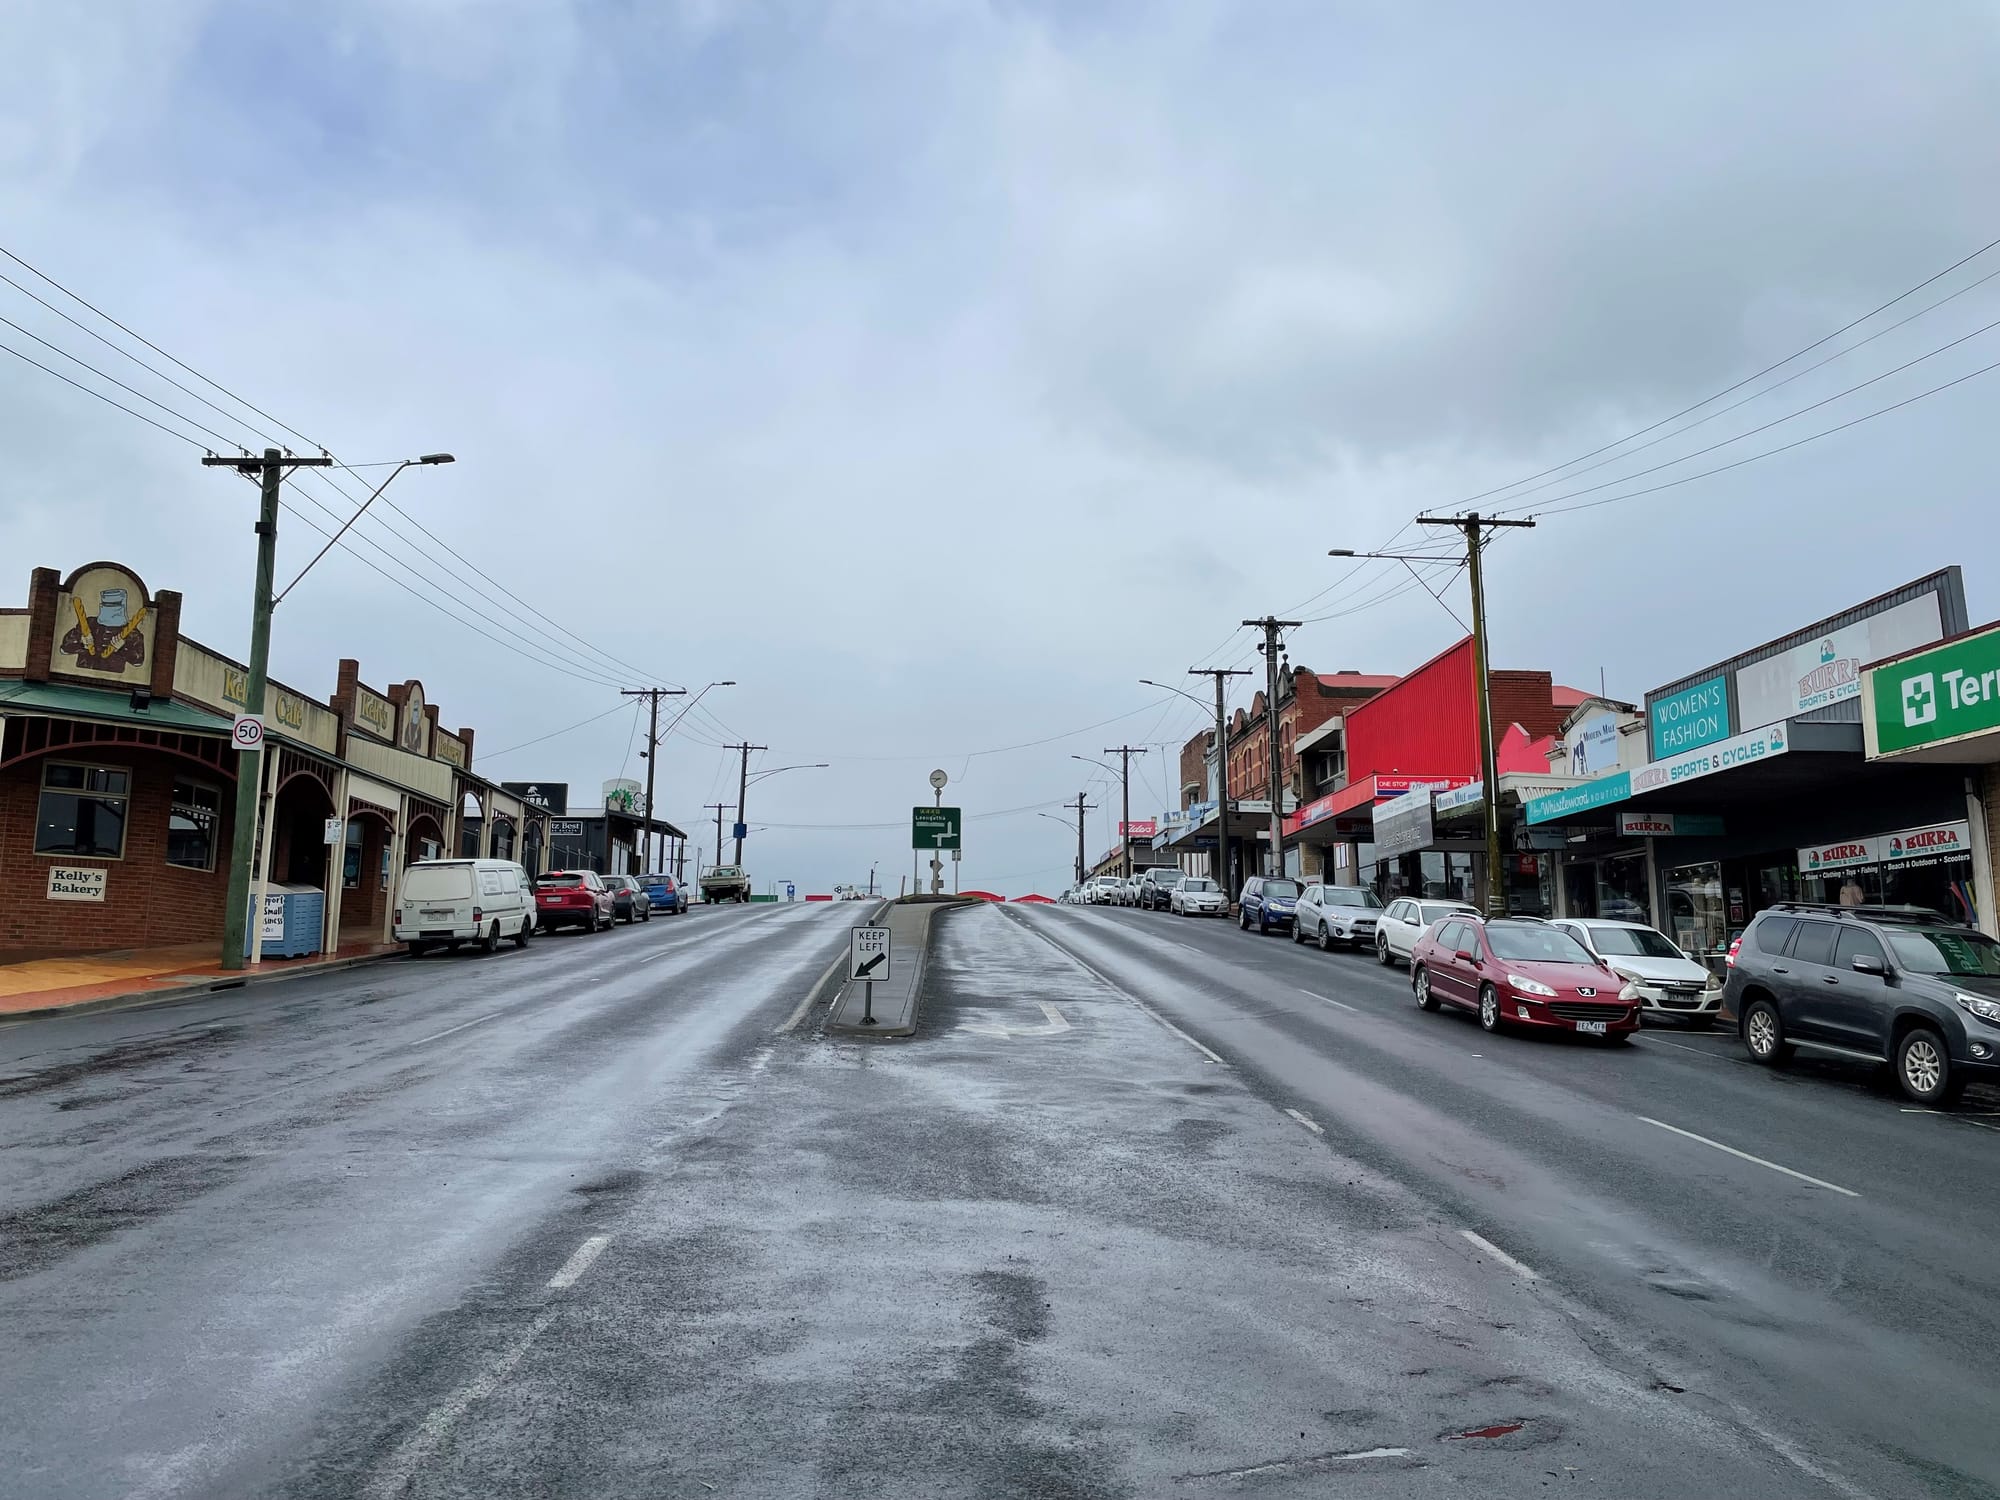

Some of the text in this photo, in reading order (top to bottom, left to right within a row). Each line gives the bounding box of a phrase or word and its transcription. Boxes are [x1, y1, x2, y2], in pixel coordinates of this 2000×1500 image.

[1798, 658, 1860, 697] BURRA
[223, 668, 248, 704] Kel
[1942, 669, 2000, 710] Ter
[1799, 682, 1861, 709] SPORTS & CYCLE
[1658, 686, 1720, 724] WOMEN'S
[238, 725, 258, 739] 50
[1663, 714, 1718, 749] FASHION
[1633, 741, 1765, 790] BURRA SPORTS & CYCLES
[1409, 779, 1450, 791] Disount
[523, 797, 549, 806] RRA
[1541, 789, 1589, 816] Whistlewood
[1624, 821, 1672, 831] BURRA
[1905, 831, 1958, 849] BURRA
[1822, 845, 1867, 861] BURRA
[1888, 862, 1905, 870] Beach
[1911, 858, 1938, 868] Outdoors
[1943, 853, 1971, 864] Scooters
[54, 870, 103, 883] Kelly's
[1823, 871, 1842, 880] Clothing
[1846, 867, 1857, 876] Toys
[1861, 866, 1878, 875] Fishing
[51, 882, 102, 897] Bakery
[255, 895, 284, 906] Spport
[263, 906, 282, 915] Small
[263, 917, 283, 925] siness
[859, 931, 885, 940] KEEP
[860, 943, 883, 951] LEFT
